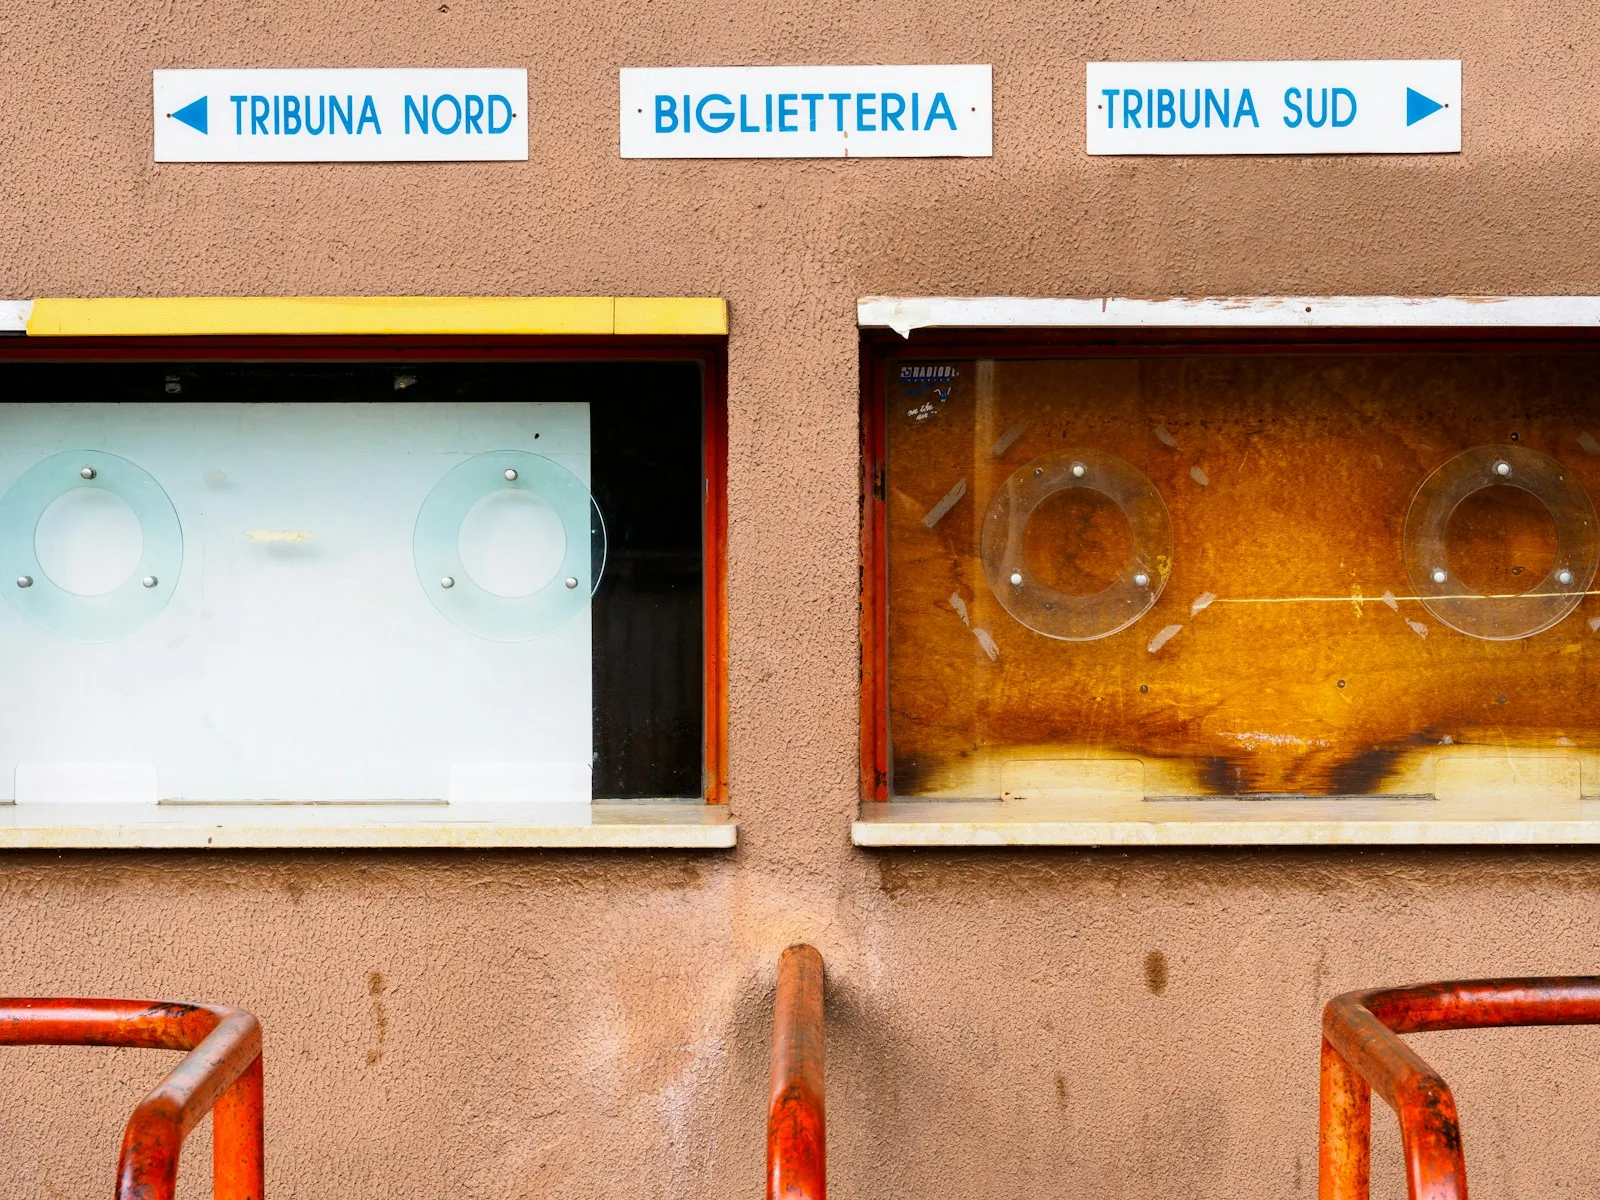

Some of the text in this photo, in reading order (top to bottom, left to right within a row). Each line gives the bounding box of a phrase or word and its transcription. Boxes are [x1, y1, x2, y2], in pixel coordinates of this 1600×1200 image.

[229, 93, 513, 136] TRIBUNA NORD
[654, 92, 958, 134] BIGLIETTERIA
[1101, 86, 1358, 129] TRIBUNA SUD
